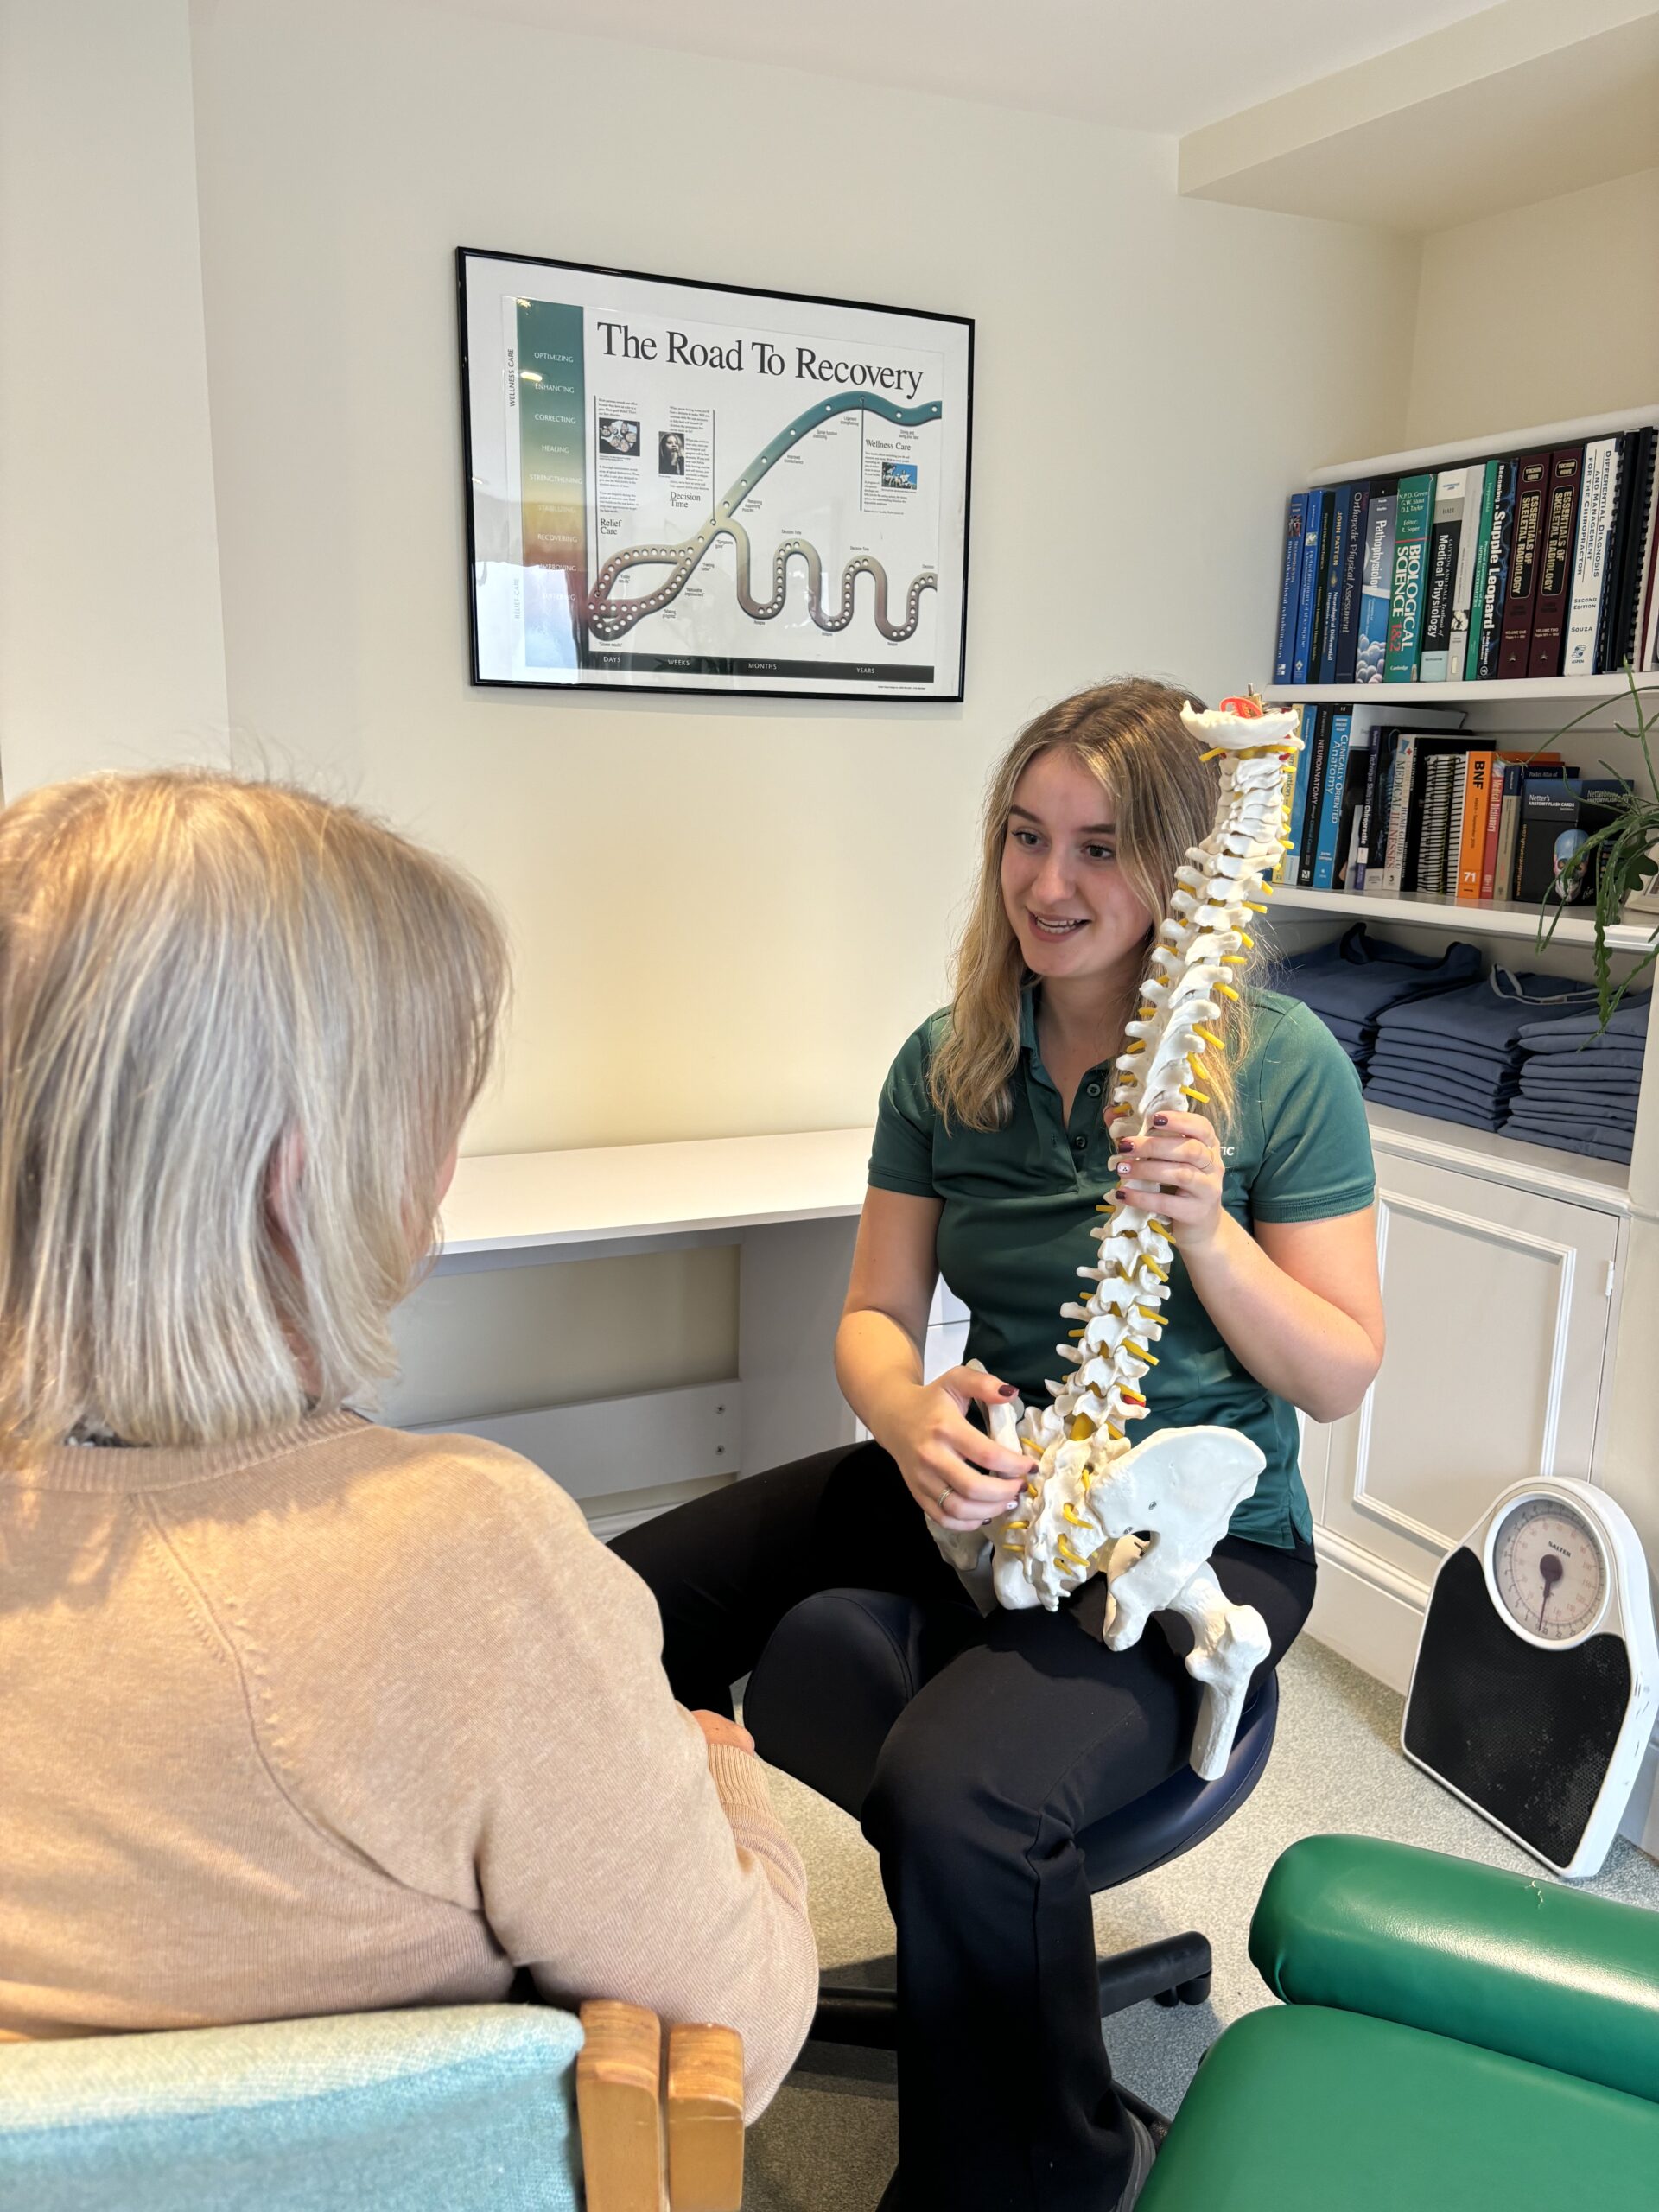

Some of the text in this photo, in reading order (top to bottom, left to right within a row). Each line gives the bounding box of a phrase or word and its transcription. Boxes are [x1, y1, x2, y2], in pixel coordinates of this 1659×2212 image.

[534, 352, 574, 363] OPTIMIZING
[597, 322, 924, 400] The Road To Recovery
[535, 382, 575, 394] ENHANCING
[534, 413, 576, 424] CORRECTING
[541, 444, 569, 454] HEALING
[866, 439, 912, 451] Wellness Care
[529, 474, 582, 485] STRENGTHENING
[670, 491, 701, 501] Decision
[1495, 465, 1505, 503] Becoming
[600, 518, 622, 528] Relief
[670, 499, 689, 508] Time
[1593, 450, 1611, 578] DIFFERENTIAL DIAGNOSIS
[537, 533, 578, 543] RECOVERING
[600, 526, 618, 535] Care
[1490, 510, 1506, 564] Supple
[1512, 497, 1530, 594] SKELETAL RADIOLOGY
[1524, 495, 1539, 564] ESSENTIALS OF
[1544, 493, 1563, 591] SKELETAL RADIOLOGY
[1556, 491, 1572, 561] ESSENTIALS OF
[1576, 500, 1590, 576] CHIROPRACTOR
[1586, 493, 1599, 561] MANAGEMENT
[539, 563, 577, 572] IMPROVING
[1343, 492, 1362, 632] Orthopedic Physical Assessment
[1389, 546, 1409, 652] SCIENCE 1&2
[1401, 544, 1421, 652] BIOLOGICAL
[1427, 534, 1449, 638] Medical Physiology
[1483, 567, 1501, 629] Leopard
[1327, 591, 1338, 661] Neurological Differential
[1312, 739, 1325, 805] NEUROANATOMY
[1326, 741, 1340, 795] Anatomy
[1337, 734, 1349, 780] CLINICALLY
[1368, 753, 1376, 783] Technique
[1473, 760, 1485, 790] BNF
[1332, 782, 1344, 823] ORIENTED
[1386, 760, 1406, 869] MEDICAL ILLNESSES
[1400, 806, 1408, 829] HOME
[1487, 779, 1503, 832] Medical Dictionary
[1360, 805, 1371, 845] Chiropractic
[1396, 830, 1406, 857] GUIDE
[1395, 859, 1402, 869] TO
[1464, 872, 1476, 883] 71
[1548, 1541, 1571, 1558] SALTER
